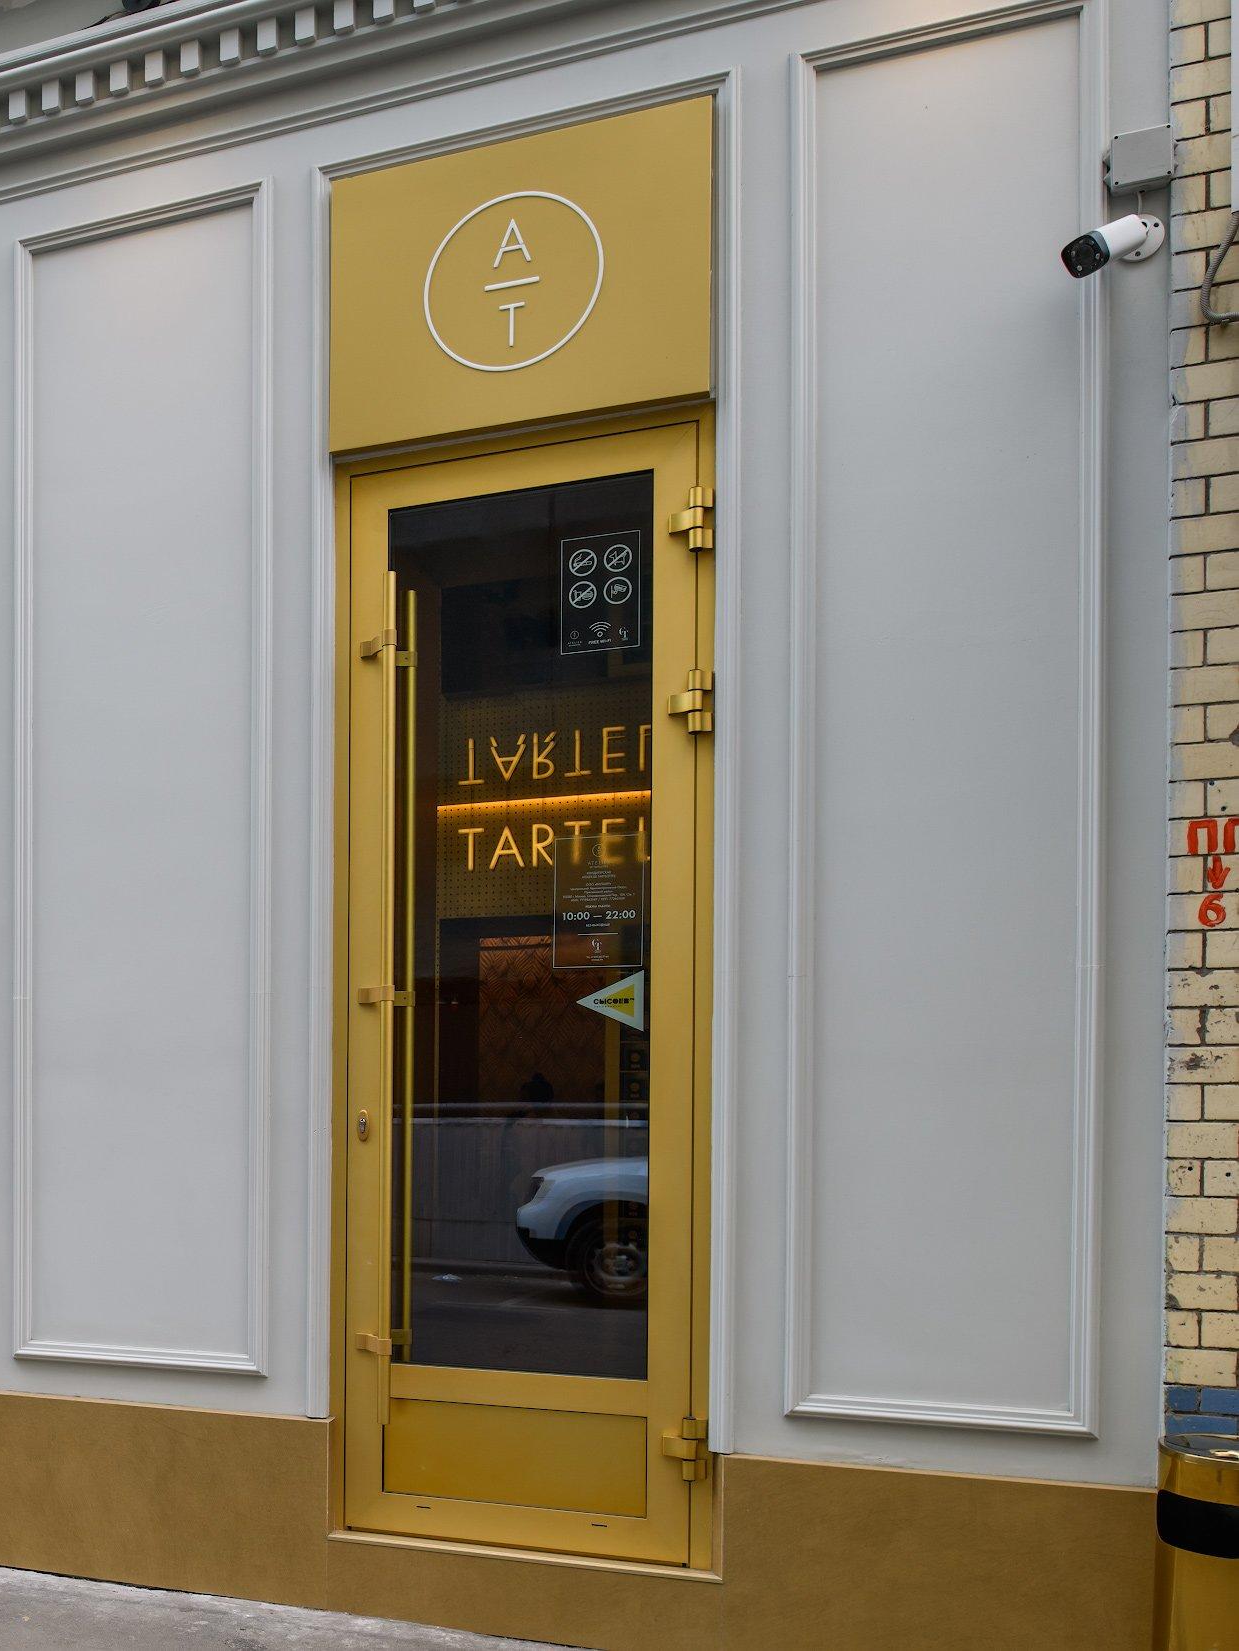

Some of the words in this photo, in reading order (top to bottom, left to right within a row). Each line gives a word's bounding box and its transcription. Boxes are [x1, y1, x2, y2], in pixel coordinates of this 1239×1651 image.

[493, 218, 531, 269] A
[499, 301, 526, 347] T
[562, 911, 590, 921] 10:00
[605, 909, 636, 920] 22:00
[1198, 893, 1227, 928] 6
